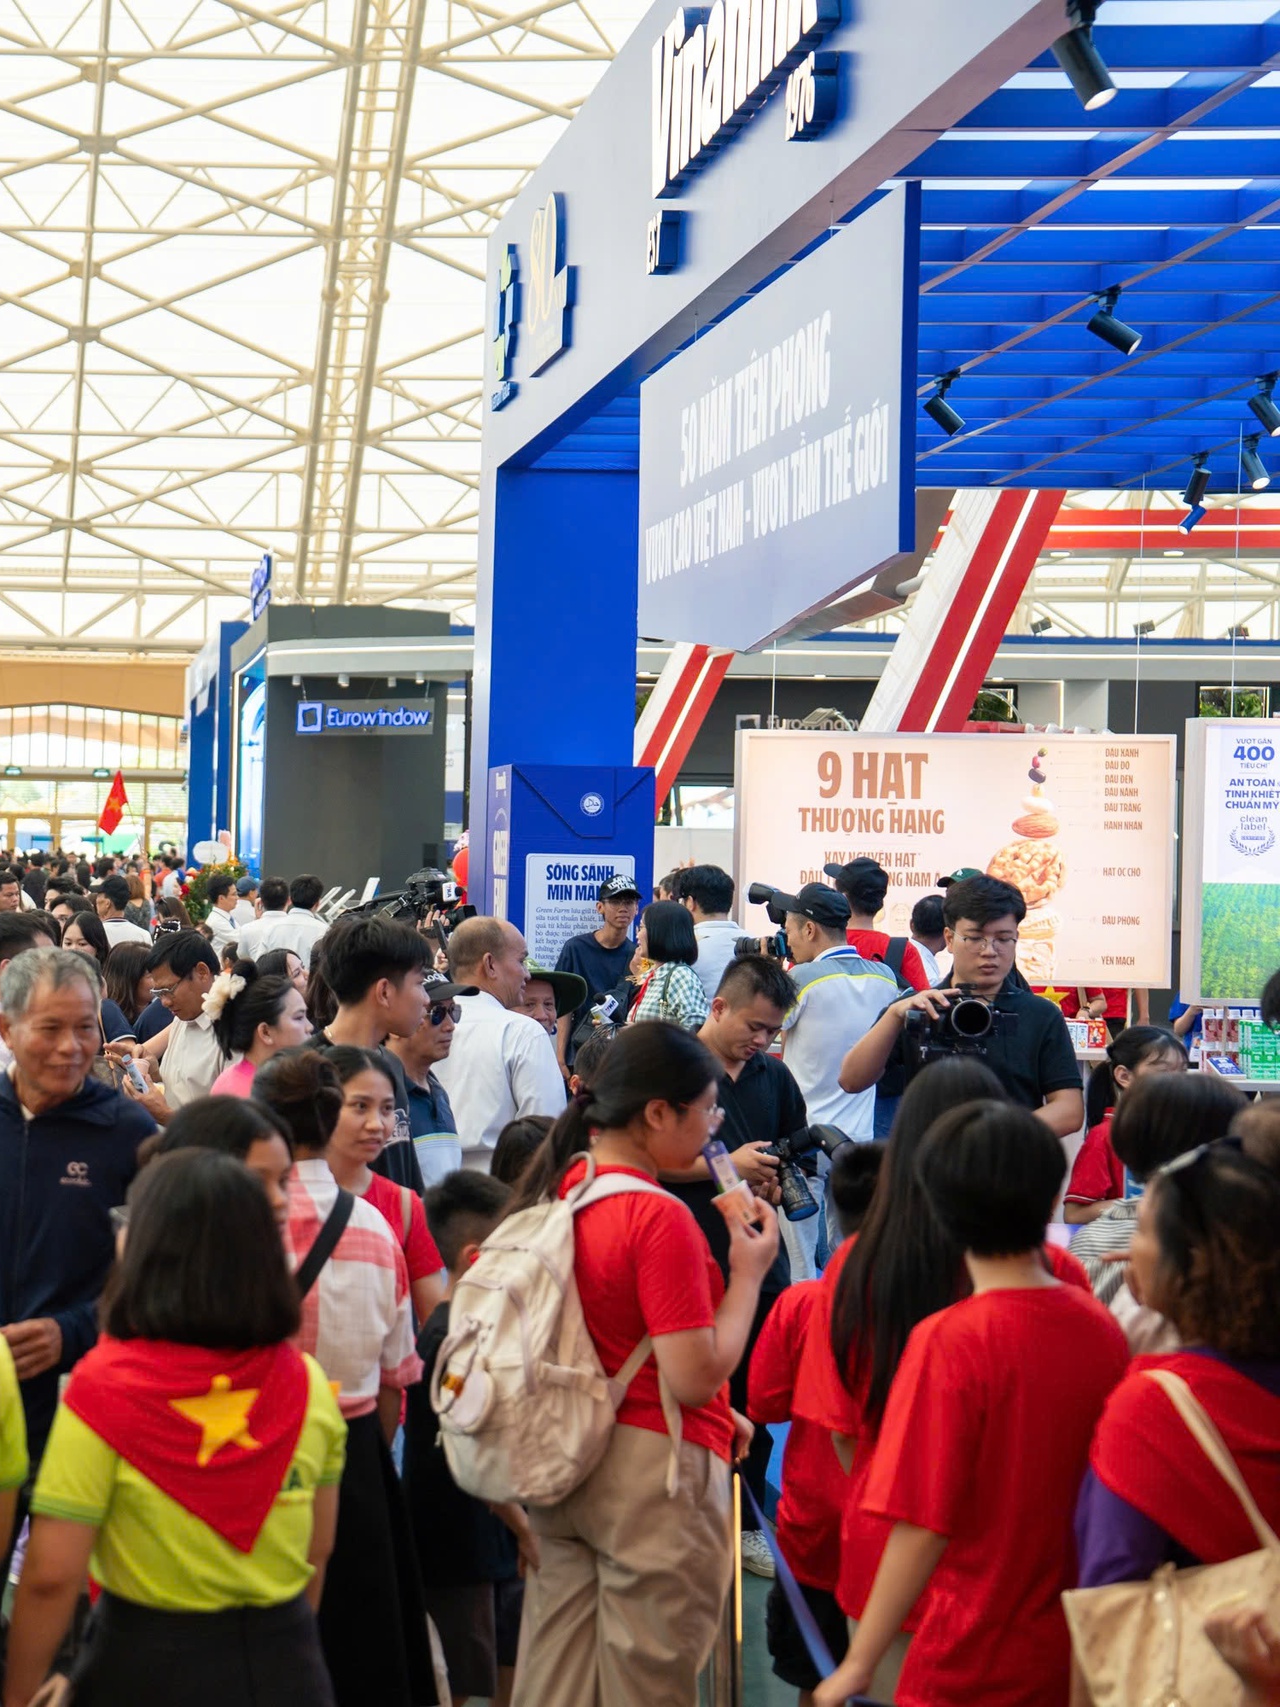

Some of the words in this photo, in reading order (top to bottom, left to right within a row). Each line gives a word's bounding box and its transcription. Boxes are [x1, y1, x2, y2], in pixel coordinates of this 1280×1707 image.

[679, 402, 698, 489] 50
[699, 375, 733, 478] NĂM
[770, 310, 832, 437] PHONG
[718, 480, 744, 555] NAM
[327, 706, 430, 727] Eurowindow
[1233, 746, 1275, 762] 400
[818, 751, 842, 799] 9
[852, 752, 928, 805] HẠT
[1230, 778, 1244, 787] AN
[1240, 814, 1268, 823] clean
[1241, 822, 1266, 831] label
[906, 872, 931, 888] NAM
[547, 884, 573, 902] MỊN
